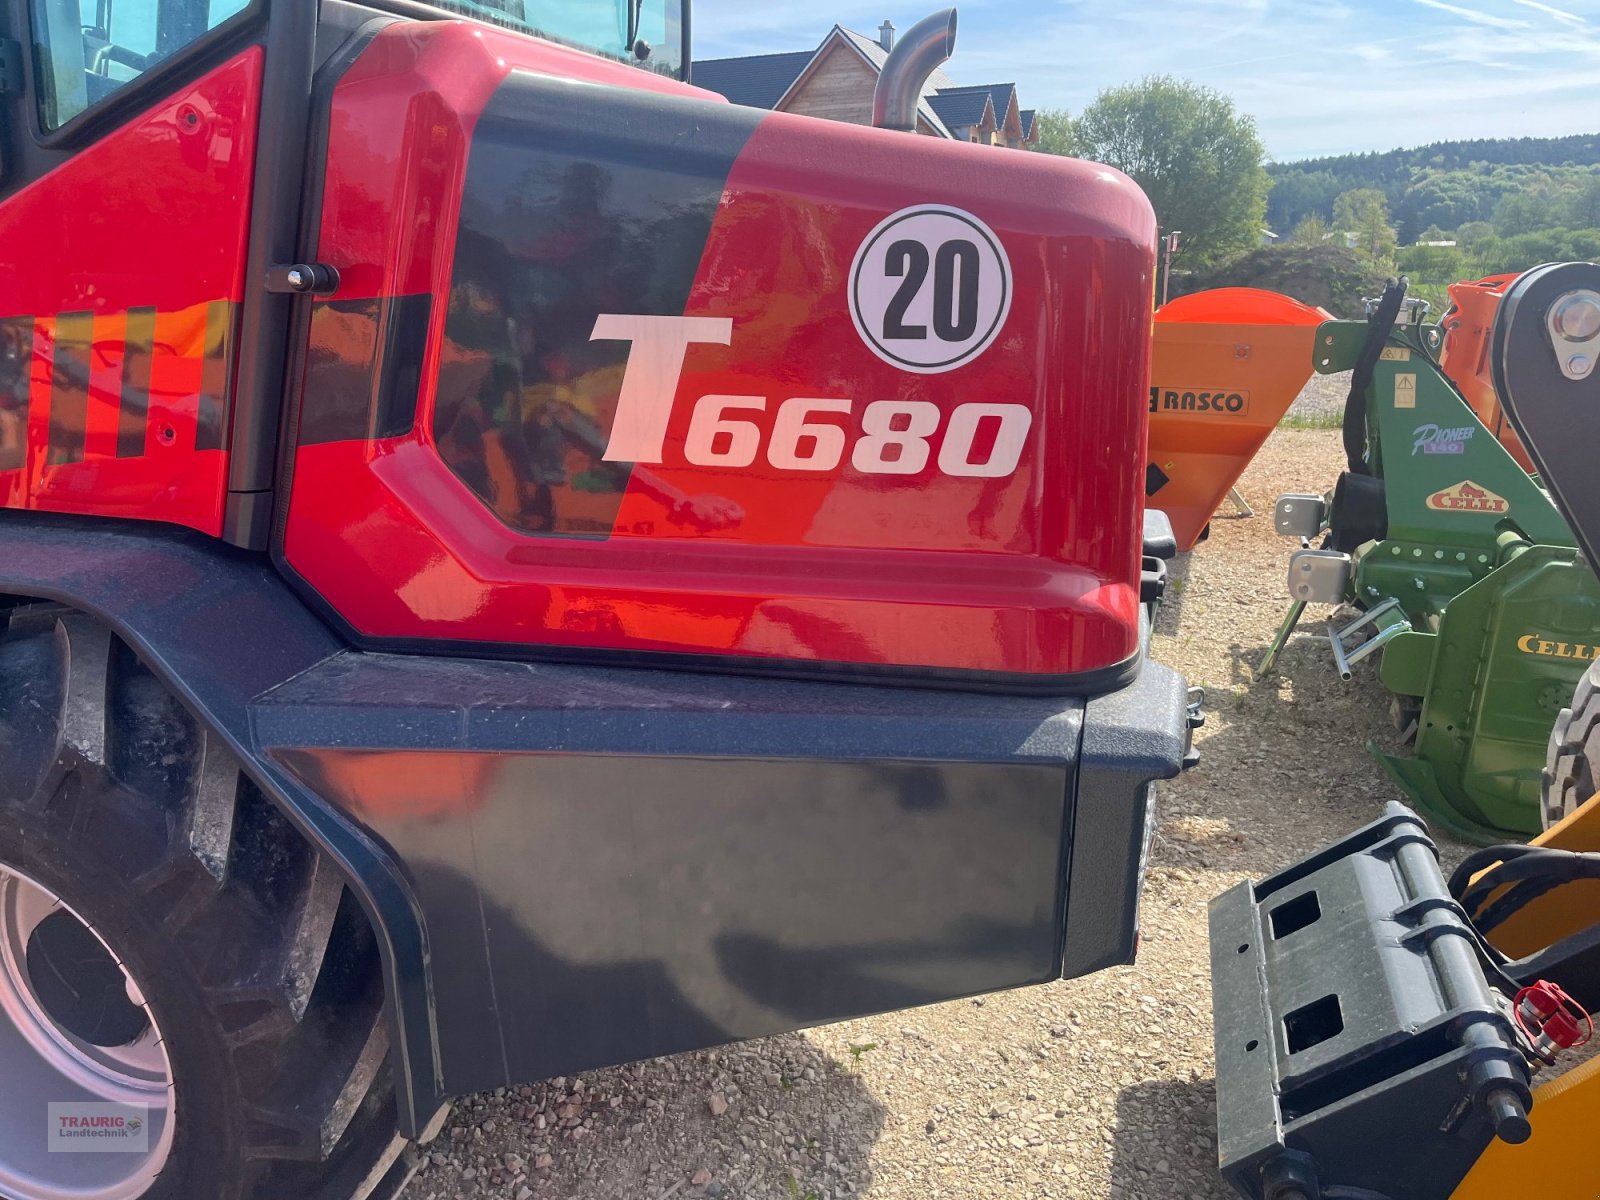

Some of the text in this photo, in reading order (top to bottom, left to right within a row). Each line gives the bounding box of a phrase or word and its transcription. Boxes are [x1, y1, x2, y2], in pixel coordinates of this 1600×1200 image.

[883, 239, 980, 342] 20
[1163, 391, 1243, 412] RASCO
[1411, 423, 1475, 456] PIONEER
[1432, 493, 1504, 512] CELLI
